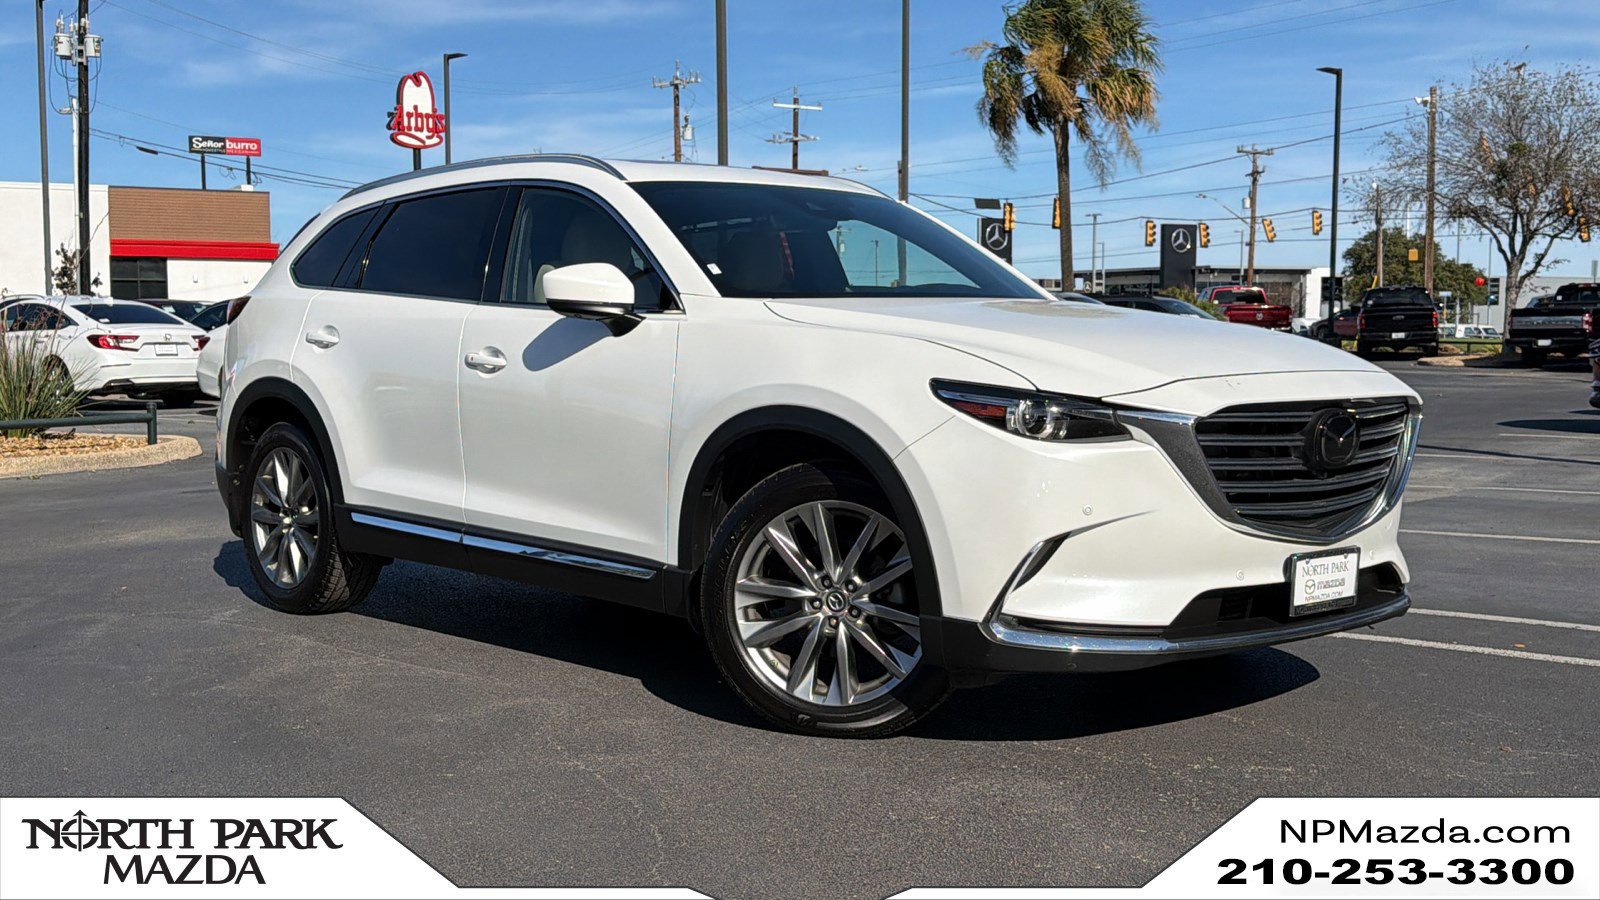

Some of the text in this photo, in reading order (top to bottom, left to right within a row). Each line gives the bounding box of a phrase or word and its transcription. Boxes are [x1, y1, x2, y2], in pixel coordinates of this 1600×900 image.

[192, 137, 258, 151] Señor burro
[1302, 560, 1349, 577] NORTH PARK
[1317, 578, 1346, 590] mazda
